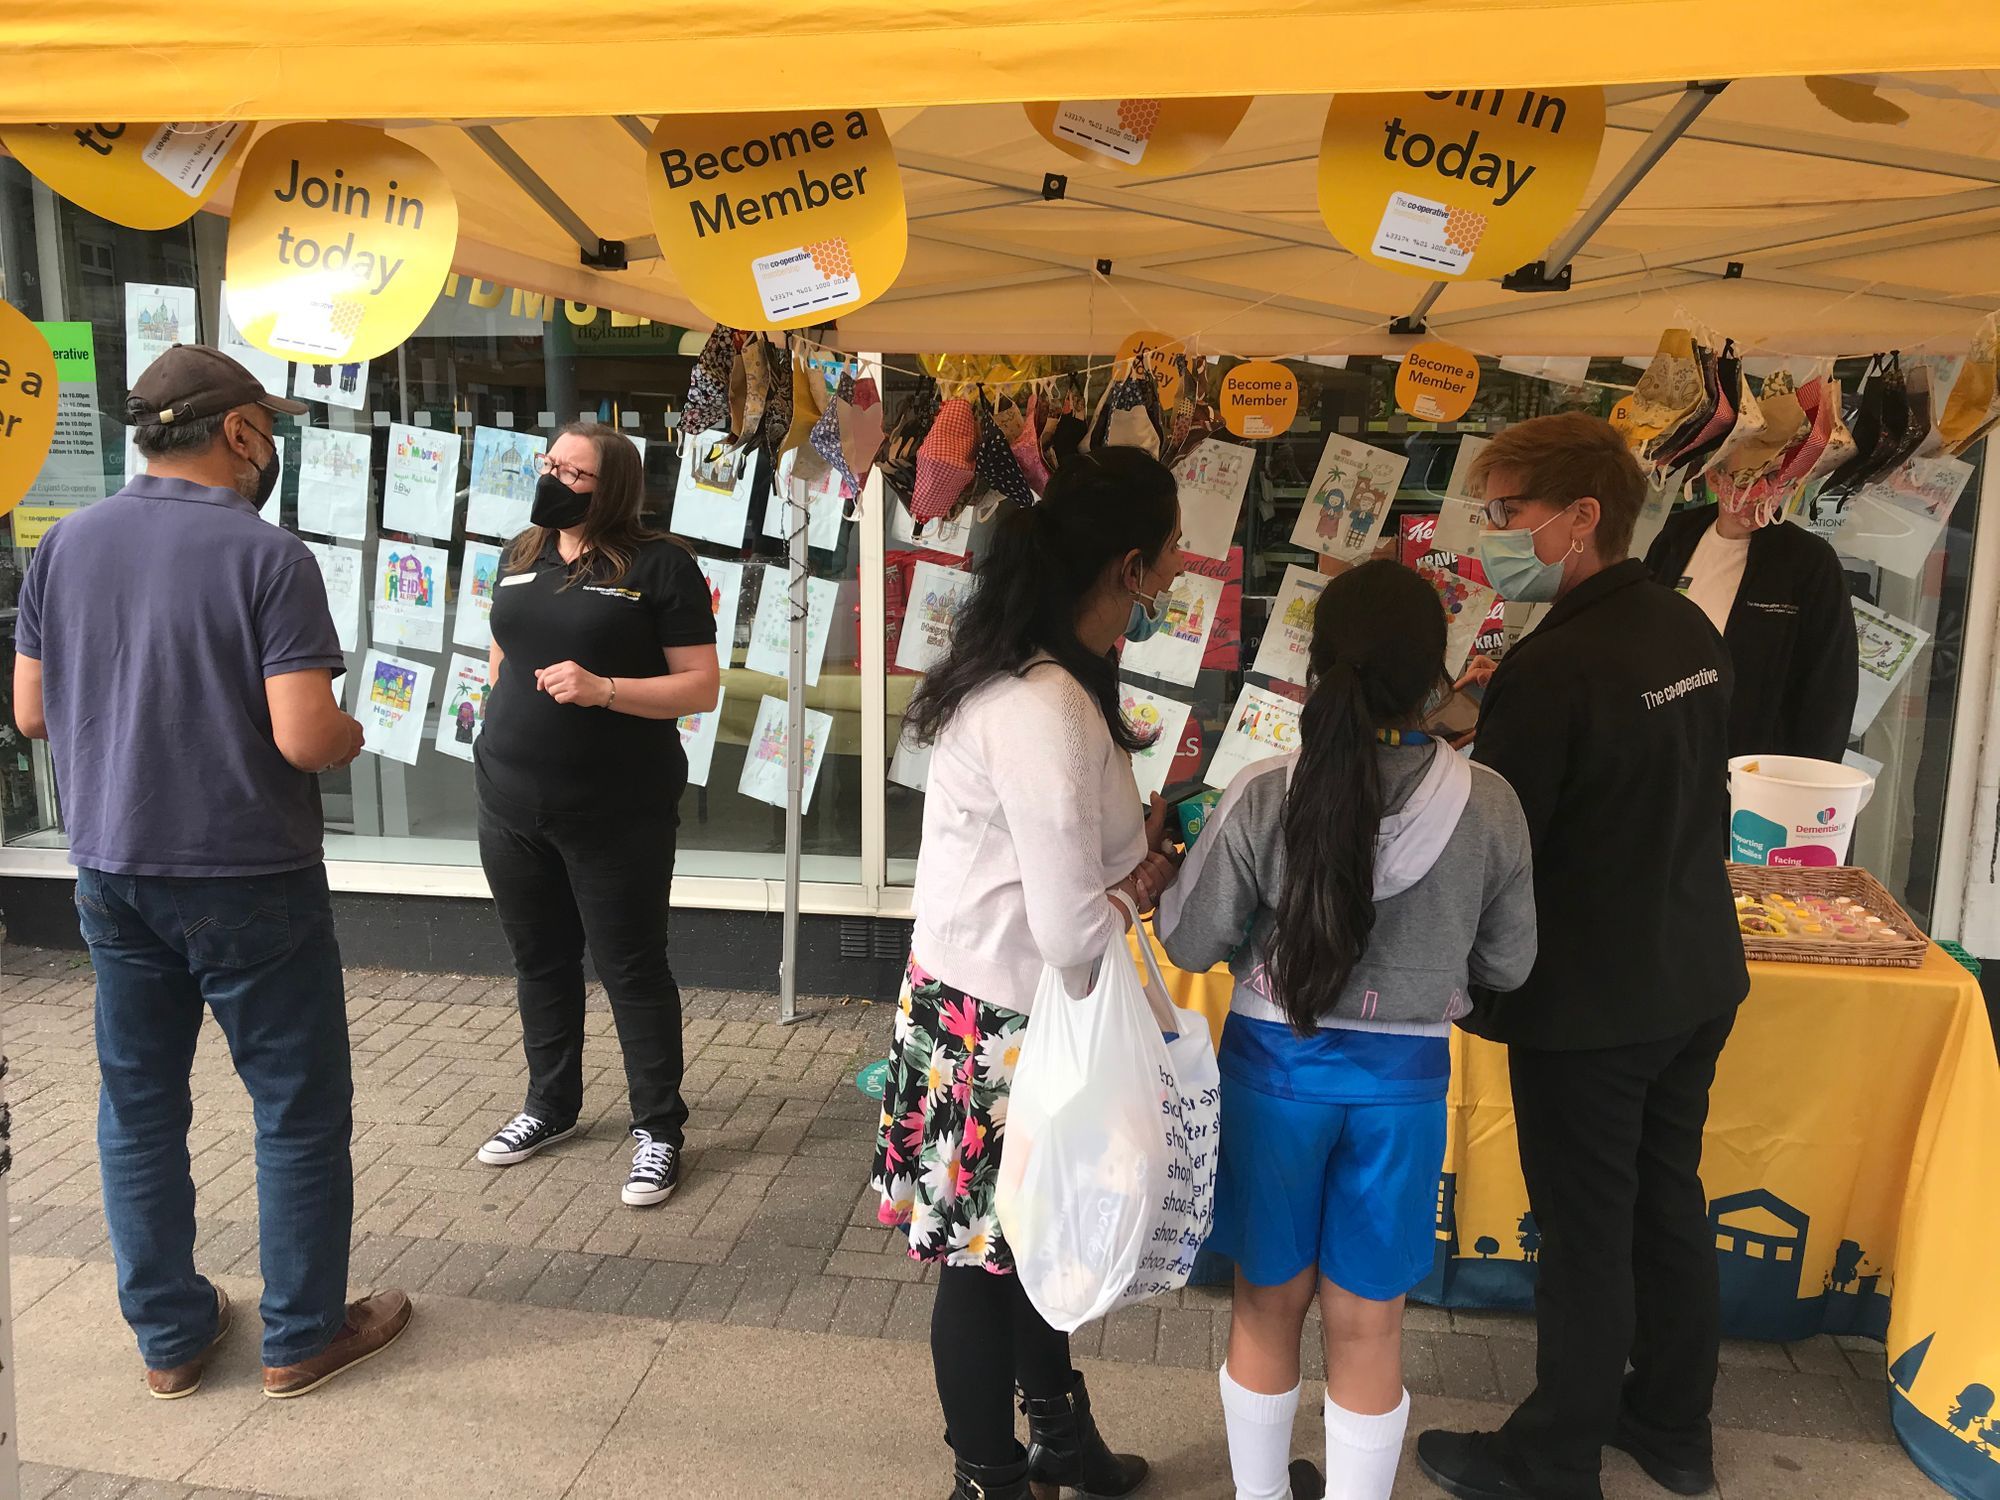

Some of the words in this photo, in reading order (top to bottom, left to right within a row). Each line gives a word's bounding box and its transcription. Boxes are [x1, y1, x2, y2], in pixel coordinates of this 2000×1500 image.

[1517, 90, 1566, 133] in
[660, 118, 835, 189] Become
[845, 111, 868, 140] a
[1384, 117, 1536, 204] today
[274, 160, 370, 218] Join
[385, 180, 424, 229] in
[690, 166, 868, 238] Member
[1407, 202, 1450, 219] co-operative
[278, 227, 404, 295] today
[770, 252, 811, 268] co-operative
[1408, 353, 1463, 377] Become
[1465, 369, 1474, 379] a
[21, 371, 43, 398] a
[1228, 377, 1281, 391] Become
[1284, 380, 1292, 390] a
[1408, 370, 1466, 394] Member
[1231, 394, 1288, 406] Member
[61, 484, 97, 493] Co-operative
[1416, 551, 1458, 569] KRAVE
[400, 578, 418, 594] EID
[1641, 691, 1665, 709] The
[1664, 668, 1719, 701] co-operative
[373, 705, 404, 721] Happy
[379, 718, 394, 729] Eid
[1737, 845, 1763, 860] families
[1774, 856, 1803, 867] facing
[866, 1076, 882, 1092] One
